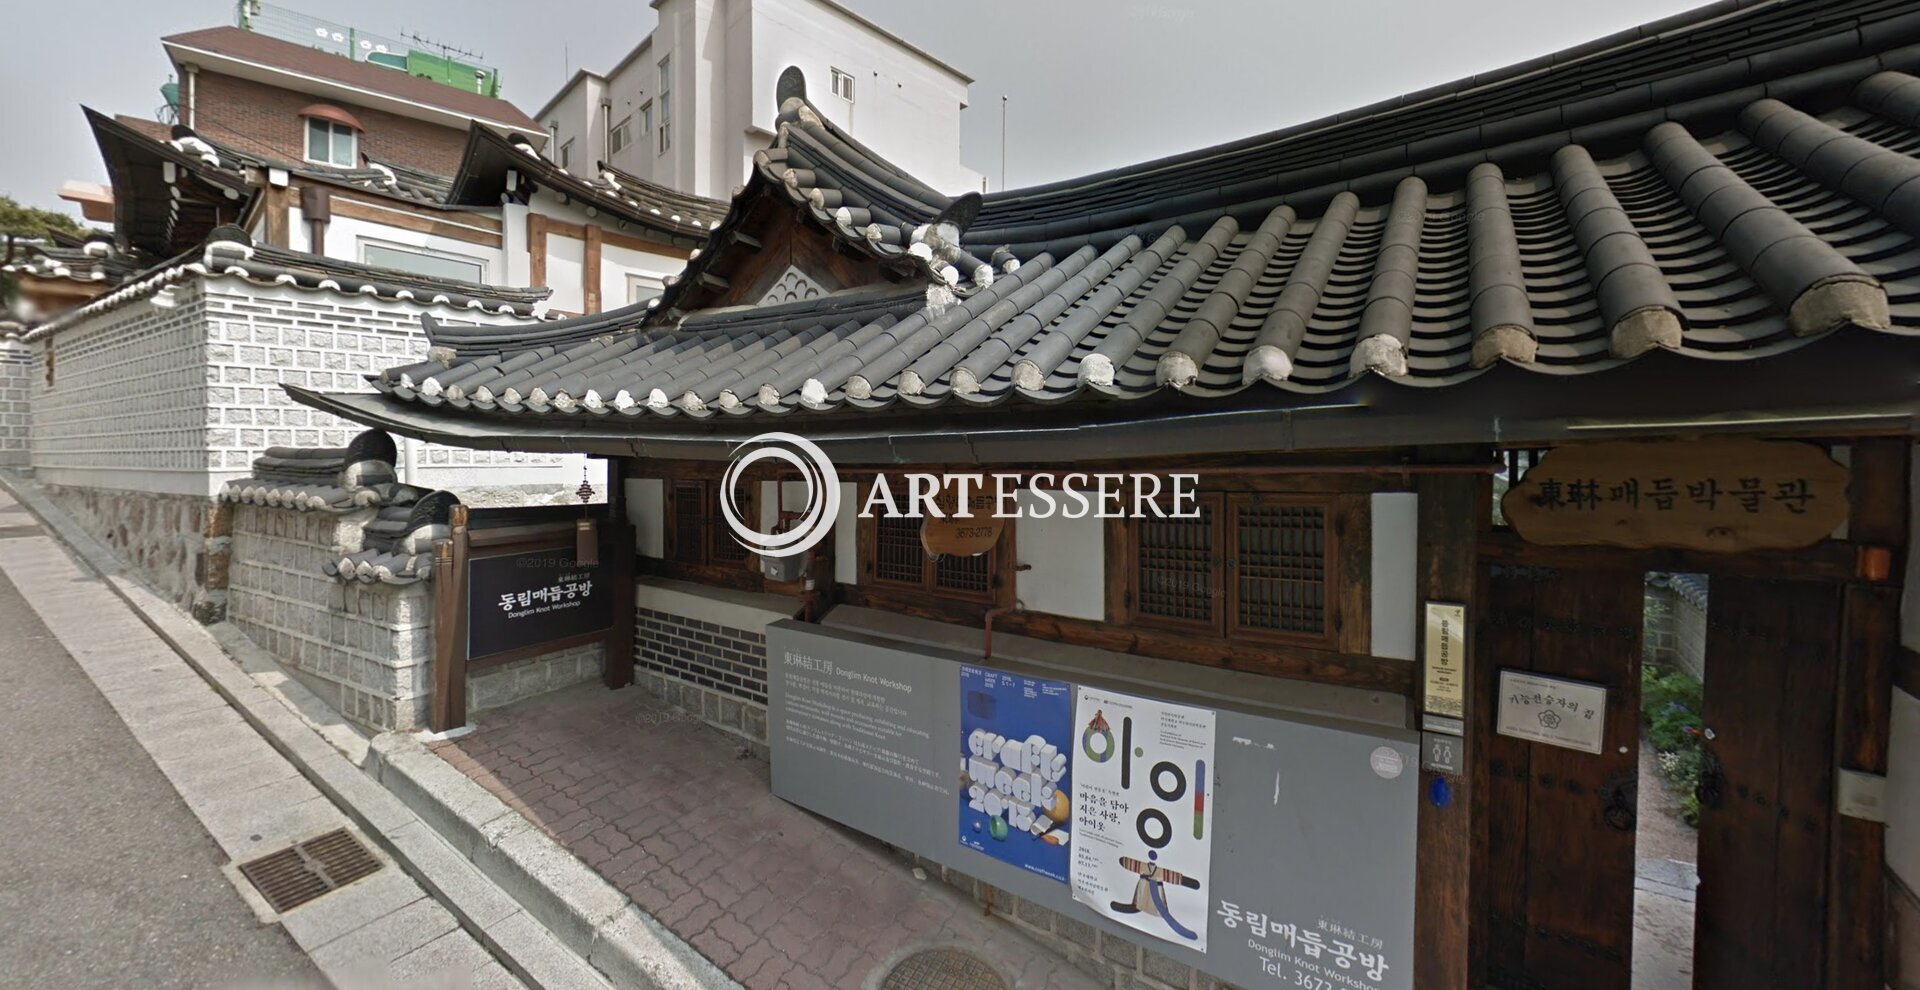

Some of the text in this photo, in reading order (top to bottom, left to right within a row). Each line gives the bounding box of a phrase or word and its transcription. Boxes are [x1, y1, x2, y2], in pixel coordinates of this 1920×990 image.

[498, 580, 593, 611] 동림매듭공방
[508, 609, 534, 619] Donglim
[552, 600, 580, 610] Workshop
[835, 666, 862, 680] Donglim
[863, 673, 878, 685] Knot
[880, 678, 913, 693] Workshop
[1080, 792, 1129, 813] 마음을 담아
[1080, 804, 1097, 817] 지은
[1079, 816, 1105, 832] 아이옷
[1217, 900, 1389, 981] 동림매듭공방
[1317, 918, 1383, 950] 東琳結工房
[1248, 938, 1291, 963] Donglim
[1295, 957, 1320, 974] Knot
[1260, 956, 1287, 980] Tel.
